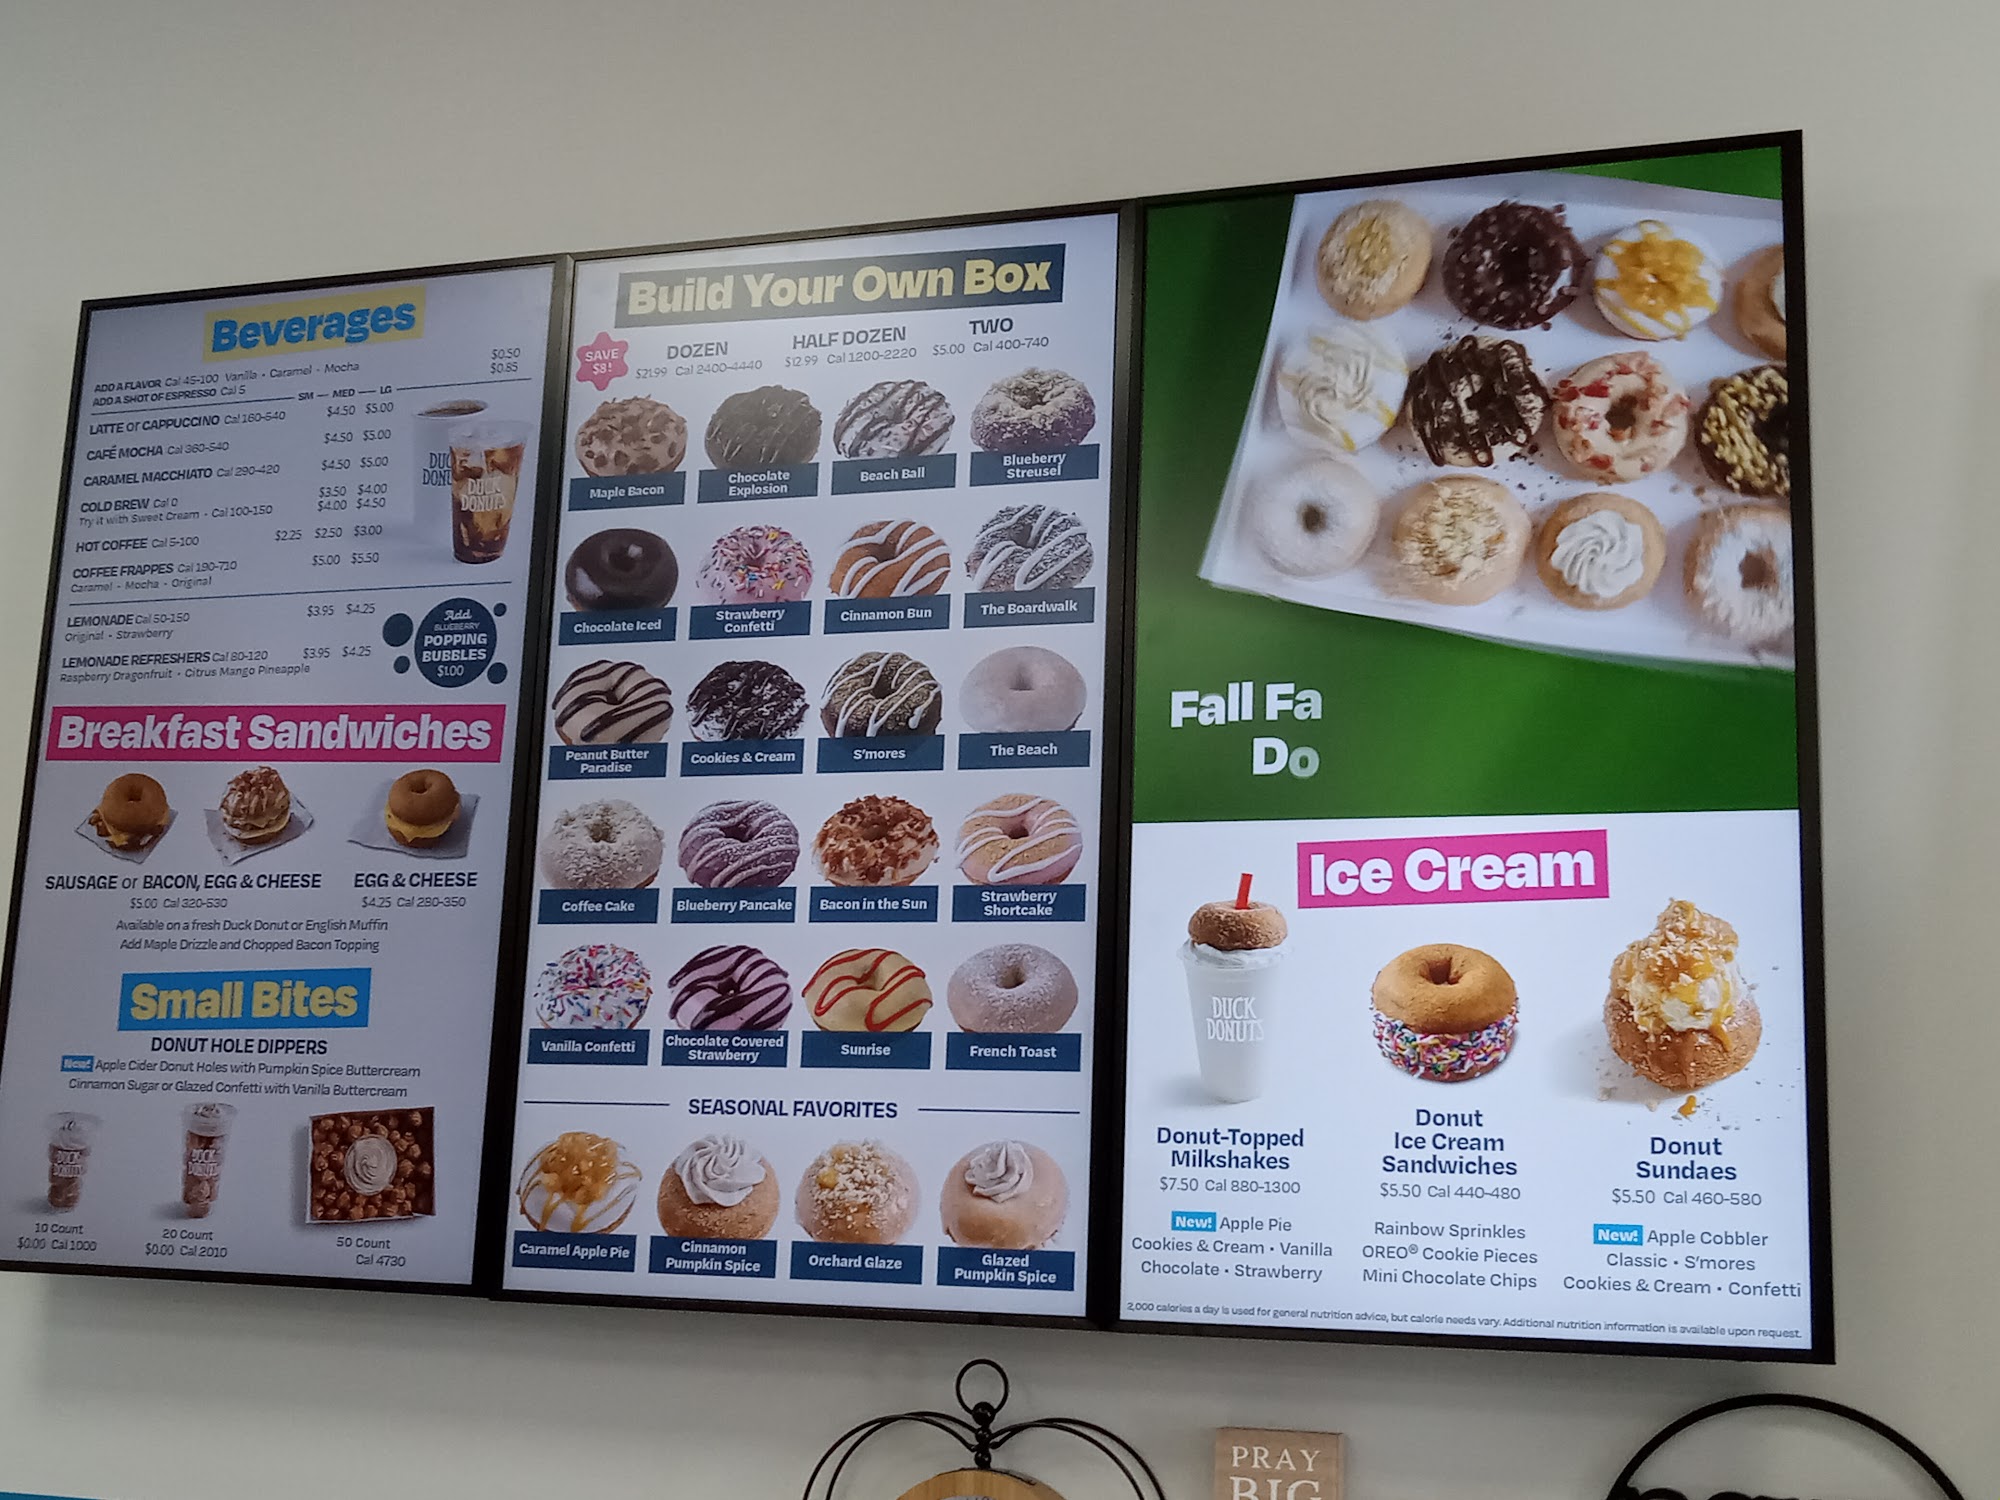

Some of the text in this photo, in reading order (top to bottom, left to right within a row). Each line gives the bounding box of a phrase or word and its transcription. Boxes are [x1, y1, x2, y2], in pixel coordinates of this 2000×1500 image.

[628, 259, 1052, 315] Build Your Own Box
[210, 302, 416, 353] Beverages
[969, 318, 1013, 335] TWO
[792, 326, 907, 349] HALF DOZEN
[932, 336, 1049, 356] $5.00 Cal 400-740
[585, 348, 620, 362] SAVE
[667, 341, 728, 360] DOZEN
[785, 347, 917, 368] $12.99 Cal 1200-2220
[592, 363, 612, 375] $8!
[327, 402, 393, 418] $4.50 $5.00
[90, 415, 219, 435] LATTE or CAPPUCCINO
[1003, 453, 1066, 467] Blueberry
[728, 471, 790, 484] Chocolate
[860, 467, 925, 482] Beach Ball
[1006, 465, 1061, 479] Streusel
[589, 485, 664, 500] Maple Bacon
[728, 484, 788, 498] Explosion
[76, 538, 148, 553] HOT COFFEE
[716, 608, 785, 622] Strawberry
[840, 608, 932, 622] Cinnamon Bun
[981, 600, 1078, 615] The Boardwalk
[724, 620, 775, 633] Confetti
[424, 633, 487, 647] POPPING
[422, 649, 486, 662] BUBBLES
[1170, 680, 1323, 728] Fall Fa
[58, 714, 492, 751] Breakfast Sandwiches
[690, 752, 796, 764] Cookies & Cream
[989, 743, 1058, 757] The Beach
[1252, 736, 1321, 779] Do
[354, 872, 477, 888] EGG & CHEESE
[1309, 847, 1596, 897] Ice Cream
[45, 874, 321, 891] SAUSAGE or BACON, EGG & CHEESE
[820, 898, 927, 911] Bacon in the Sun
[981, 891, 1057, 904] Strawberry
[562, 900, 635, 913] Coffee Cake
[677, 899, 792, 914] Blueberry Pancake
[983, 904, 1053, 917] Shortcake
[131, 980, 357, 1020] Small Bites
[1211, 996, 1257, 1020] DUCK
[1206, 1018, 1265, 1042] DONUTS
[151, 1037, 327, 1055] DONUT HOLE DIPPERS
[665, 1035, 784, 1048] Chocolate Covered
[841, 1044, 891, 1056] Sunrise
[688, 1049, 759, 1064] Strawberry
[970, 1045, 1057, 1058] French Toast
[688, 1098, 898, 1118] SEASONAL FAVORITES
[1416, 1108, 1483, 1127] Donut
[1157, 1127, 1304, 1151] Donut-Topped
[1394, 1132, 1504, 1151] Ice Cream
[1650, 1137, 1723, 1156] Donut
[1171, 1149, 1290, 1170] Milkshakes
[1382, 1154, 1518, 1176] Sandwiches
[1636, 1160, 1737, 1180] Sundaes
[1159, 1177, 1300, 1194] $7.50 Cal 880-1300
[1380, 1182, 1521, 1200] $5.50 Cal 440-480
[1612, 1188, 1762, 1206] $5.50 Cal 460-580
[1175, 1216, 1292, 1233] New! Apple Pie
[1375, 1221, 1526, 1240] Rainbow Sprinkles
[162, 1229, 213, 1240] 20 Count
[1598, 1229, 1768, 1246] New! Apple Cobbler
[681, 1241, 746, 1255] Cinnamon
[1132, 1237, 1333, 1257] Cookies & Cream Vanilla
[1422, 1247, 1479, 1261] Cookie
[1484, 1248, 1538, 1264] Pieces
[665, 1257, 761, 1275] Pumpkin Spice
[808, 1254, 902, 1270] Orchard Glaze
[982, 1253, 1029, 1267] Glazed
[1607, 1253, 1667, 1268] Classic
[955, 1267, 1057, 1285] Pumpkin Spice
[1141, 1260, 1322, 1283] Chocolate Strawberry
[1363, 1268, 1537, 1291] Mini Chocolate Chips
[1563, 1276, 1801, 1298] Cookies & Cream Confetti
[1127, 1303, 1154, 1312] 2,000
[1156, 1304, 1192, 1314] calories
[1203, 1305, 1220, 1316] day
[1222, 1306, 1229, 1315] is
[1232, 1306, 1255, 1316] used
[1257, 1307, 1271, 1317] for
[1273, 1309, 1308, 1319] general
[1311, 1310, 1353, 1320] nutrition
[1355, 1312, 1389, 1323] advice,
[1391, 1313, 1408, 1322] but
[1410, 1314, 1443, 1324] calorie
[1446, 1316, 1476, 1325] needs
[1478, 1318, 1501, 1328] vary.
[1503, 1318, 1554, 1328] Additional
[1557, 1320, 1602, 1331] nutrition
[1604, 1321, 1665, 1333] information
[1668, 1324, 1677, 1333] is
[1680, 1324, 1725, 1336] available
[1728, 1327, 1755, 1337] upon
[1758, 1328, 1802, 1339] request.
[1232, 1446, 1320, 1472] PRAY
